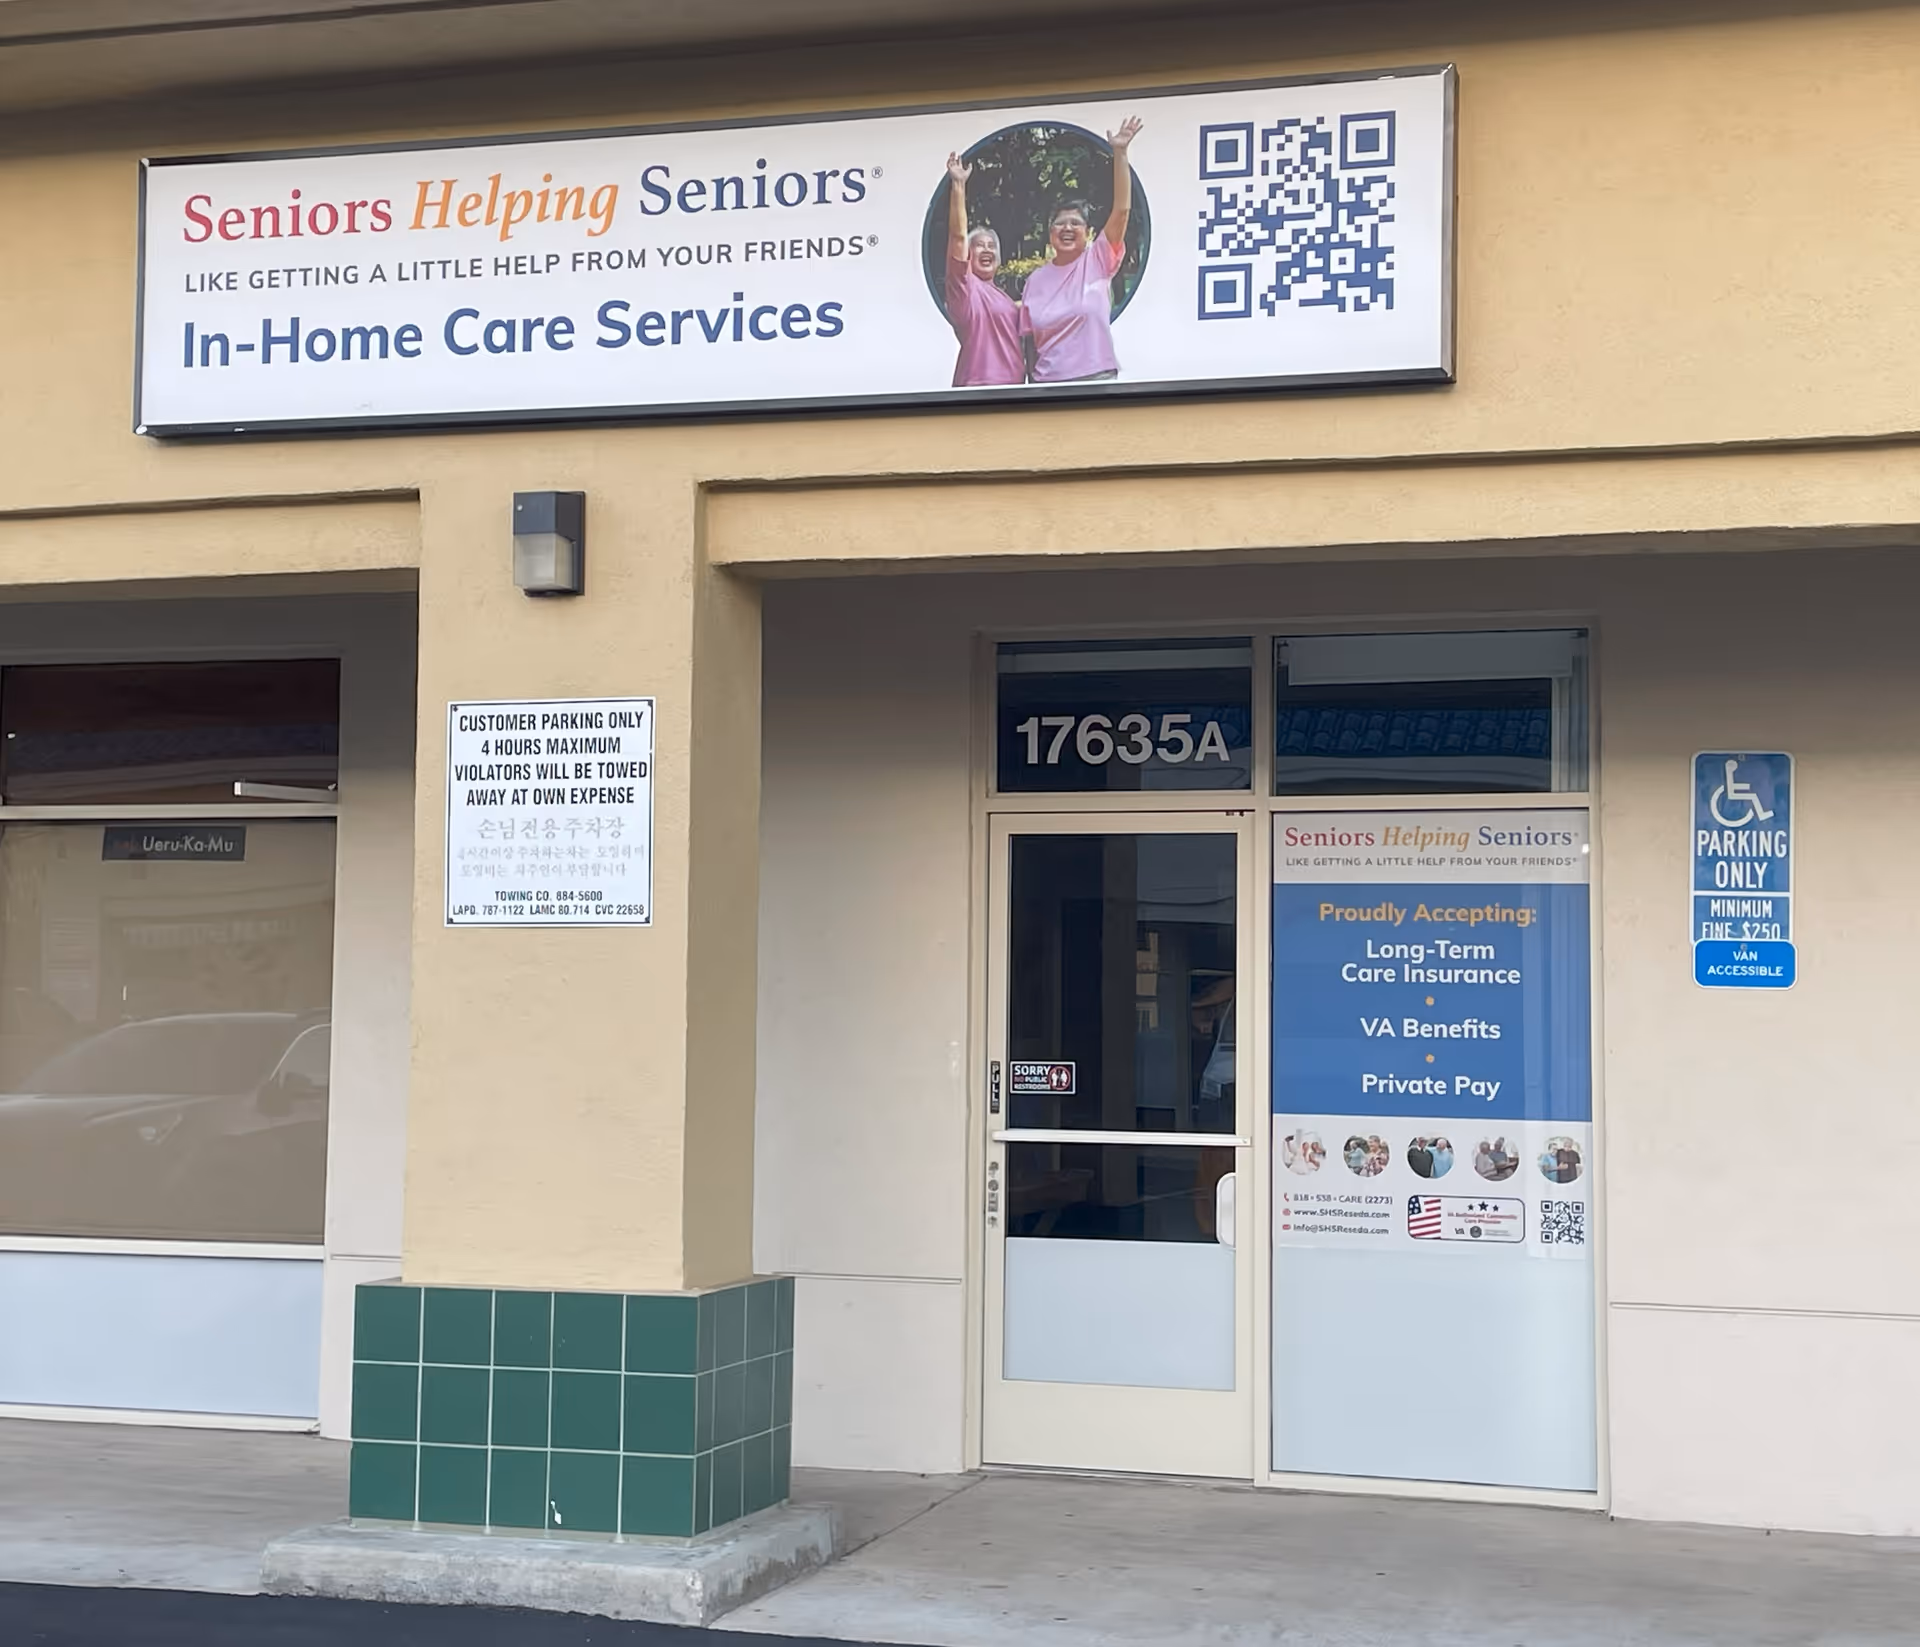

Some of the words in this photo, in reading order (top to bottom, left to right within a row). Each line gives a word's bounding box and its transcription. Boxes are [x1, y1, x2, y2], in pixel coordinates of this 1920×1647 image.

[183, 189, 392, 242] Seniors
[409, 172, 619, 241] Helping
[186, 270, 238, 293] LIKE
[249, 264, 359, 290] GETTING
[369, 263, 387, 282] A
[397, 258, 484, 282] LITTLE
[494, 253, 561, 277] HELP
[571, 247, 647, 273] FROM
[655, 242, 732, 268] YOUR
[183, 316, 423, 368] In-Home
[443, 307, 575, 355] Care
[595, 292, 844, 349] Services
[459, 714, 536, 732] CUSTOMER
[541, 712, 603, 730] PARKING
[608, 711, 644, 729] ONLY
[481, 740, 490, 756] 4
[495, 738, 542, 756] HOURS
[546, 737, 621, 755] MAXIMUM
[1016, 714, 1230, 765] 17635A
[455, 764, 531, 781] VIOLATORS
[536, 763, 569, 780] WILL
[575, 762, 592, 779] BE
[598, 761, 648, 779] TOWED
[466, 789, 506, 806] AWAY
[511, 788, 529, 805] AT
[533, 788, 566, 805] OWN
[570, 787, 635, 804] EXPENSE
[1284, 827, 1375, 847] Seniors
[1382, 826, 1470, 852] Helping
[1697, 830, 1787, 858] PARKING
[1286, 857, 1309, 866] LIKE
[1313, 857, 1361, 866] GETTING
[1365, 857, 1373, 866] A
[1377, 857, 1413, 866] LITTLE
[1417, 857, 1446, 866] HELP
[1450, 857, 1482, 866] FROM
[1485, 857, 1518, 866] YOUR
[1715, 861, 1768, 888] ONLY
[495, 890, 533, 901] TOWING
[536, 890, 552, 901] CO.
[556, 890, 603, 901] 884-5600
[451, 904, 480, 915] LAPD.
[482, 904, 524, 915] 787-1122
[529, 904, 555, 915] LAMC
[558, 904, 590, 915] 80.714
[595, 904, 614, 915] CVC
[616, 904, 645, 915] 22658
[1319, 902, 1407, 927] Proudly
[1413, 902, 1537, 928] Accepting:
[1711, 899, 1772, 918] MINIMUM
[1702, 922, 1733, 939] FINE
[1742, 921, 1781, 939] $250
[1366, 939, 1495, 964] Long-Term
[1733, 951, 1757, 961] VAN
[1341, 963, 1396, 983] Care
[1404, 964, 1521, 984] Insurance
[1707, 965, 1783, 976] ACCESSIBLE
[1360, 1017, 1396, 1038] VA
[1403, 1017, 1501, 1040] Benefits
[1014, 1065, 1051, 1075] SORRY
[992, 1065, 1000, 1102] PULL
[1361, 1073, 1448, 1095] Private
[1454, 1075, 1501, 1102] Pay
[1339, 1195, 1362, 1203] CARE
[1365, 1195, 1393, 1205] (2273)
